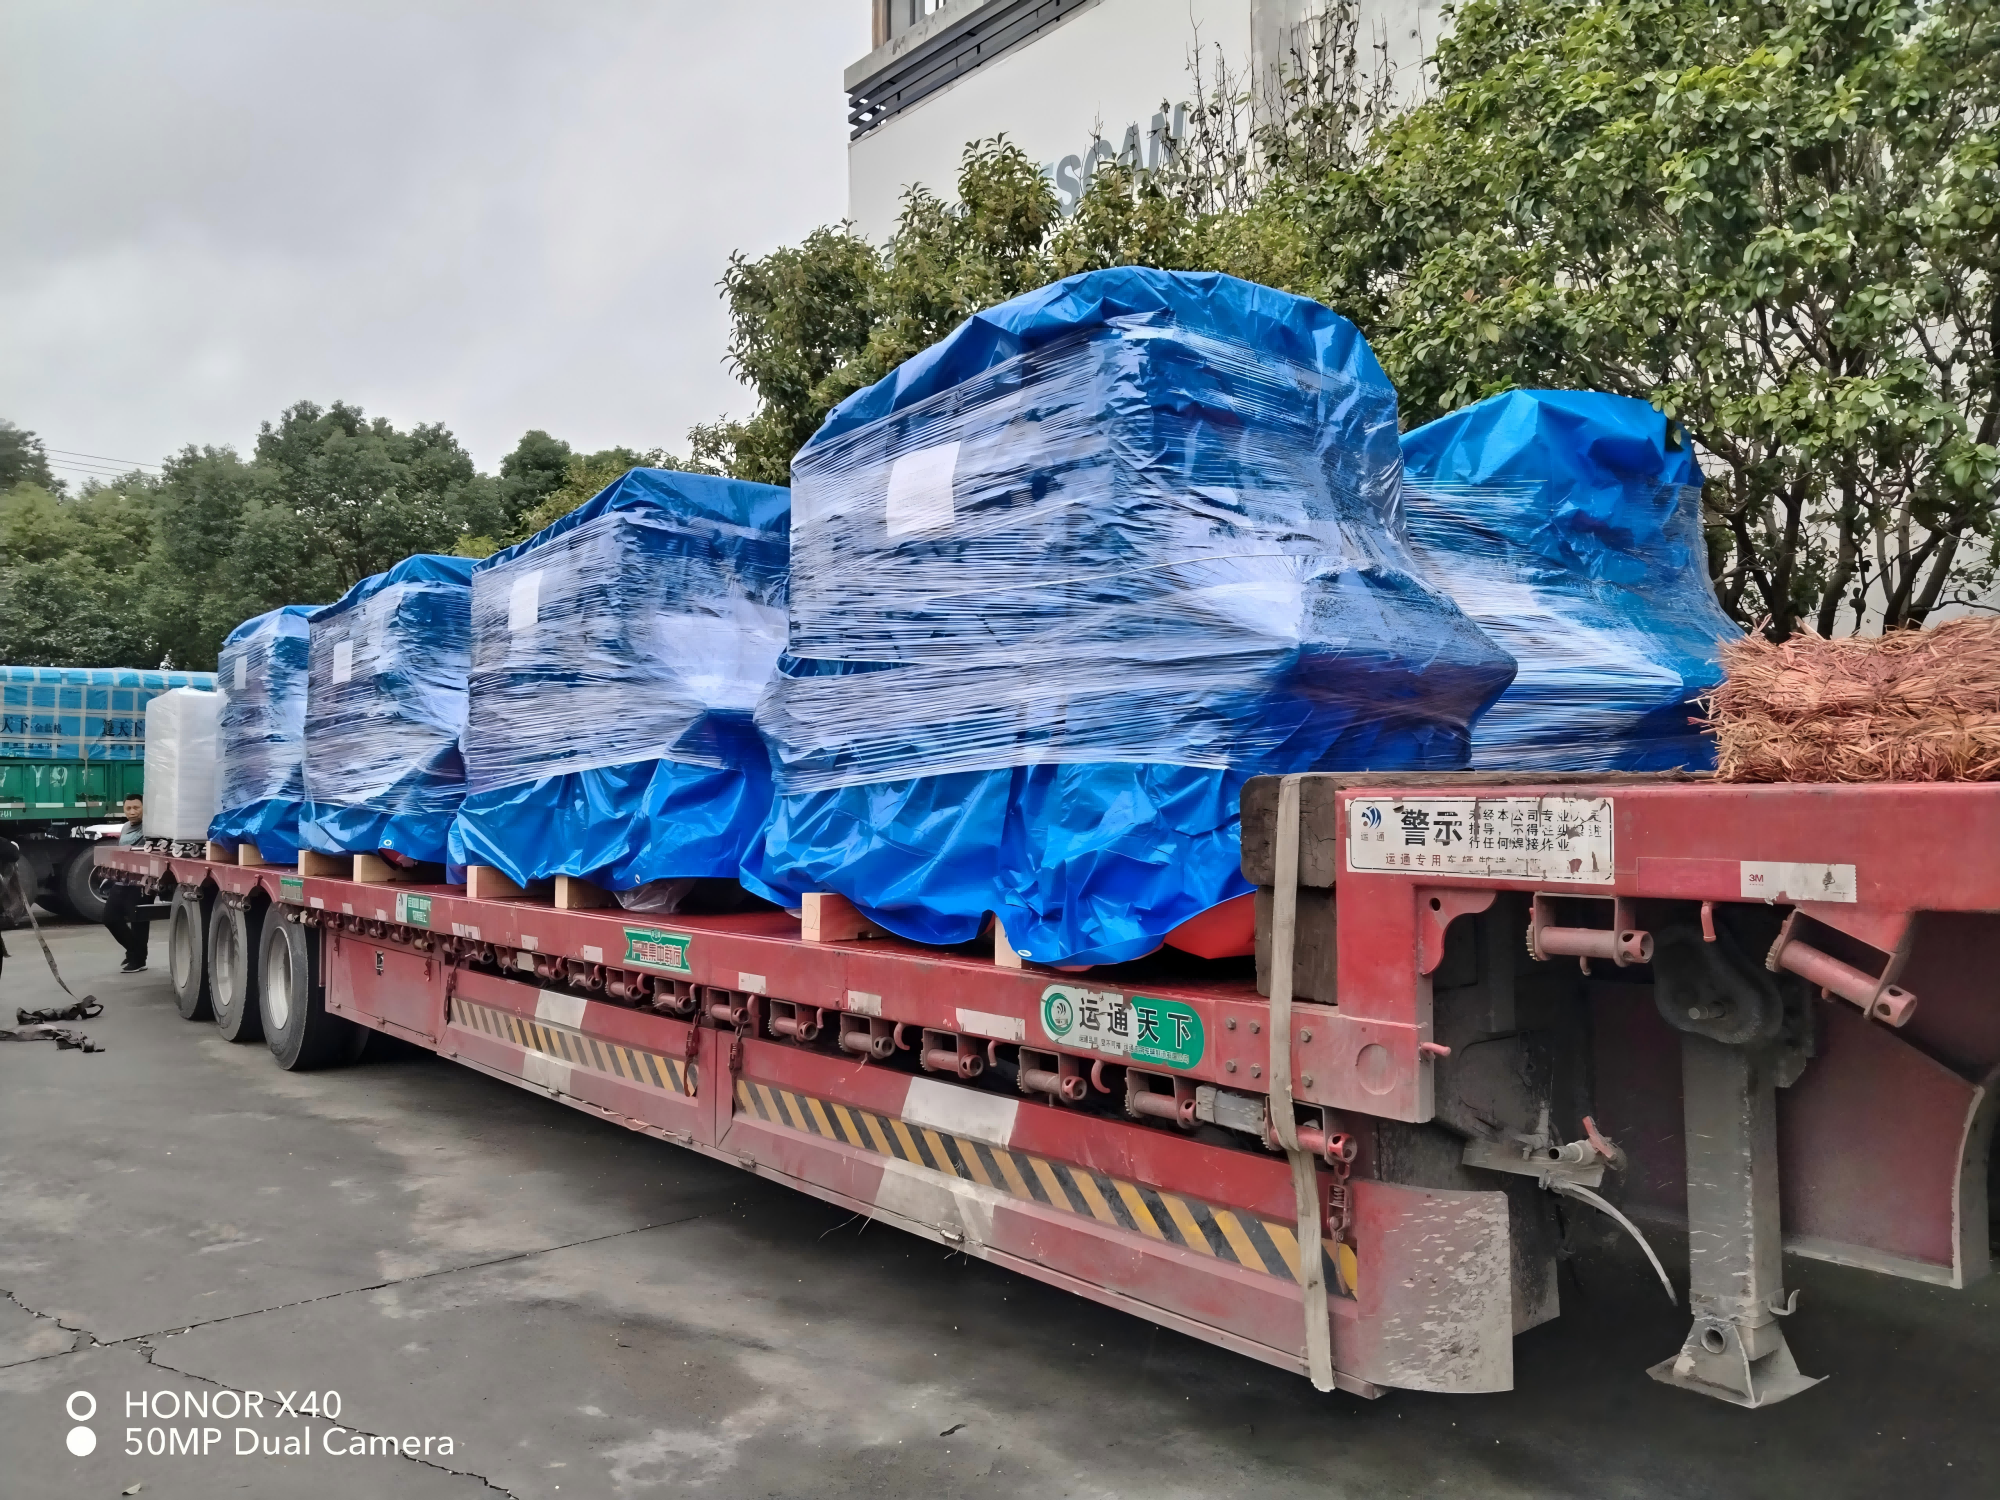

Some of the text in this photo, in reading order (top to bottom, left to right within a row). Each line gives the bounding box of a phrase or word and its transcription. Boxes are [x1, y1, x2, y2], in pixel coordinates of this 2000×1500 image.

[1401, 808, 1462, 847] 警示
[1749, 873, 1764, 883] 3M
[1079, 997, 1193, 1050] 运通天下
